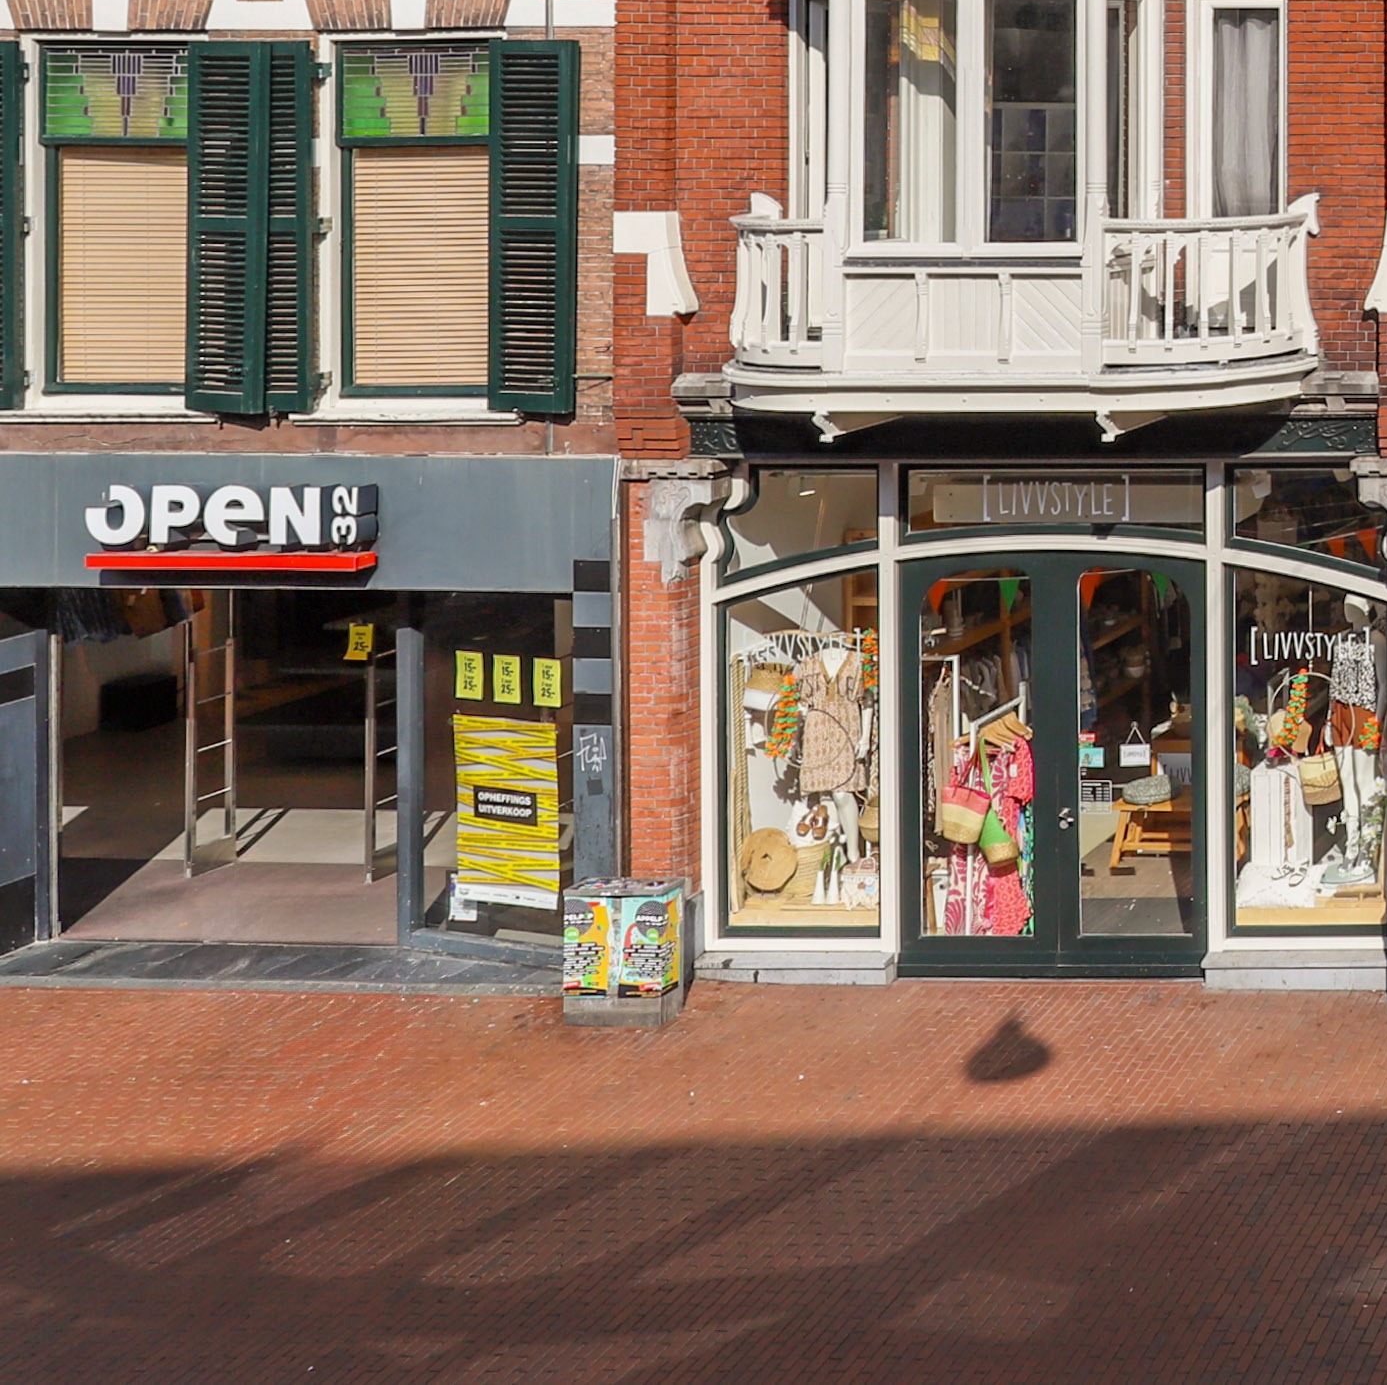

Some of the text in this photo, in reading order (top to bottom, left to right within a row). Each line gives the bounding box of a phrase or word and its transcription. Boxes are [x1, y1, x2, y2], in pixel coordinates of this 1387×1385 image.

[331, 486, 358, 546] 32
[477, 791, 532, 806] OPHEFFINGS
[478, 803, 532, 817] UITVERKOOP
